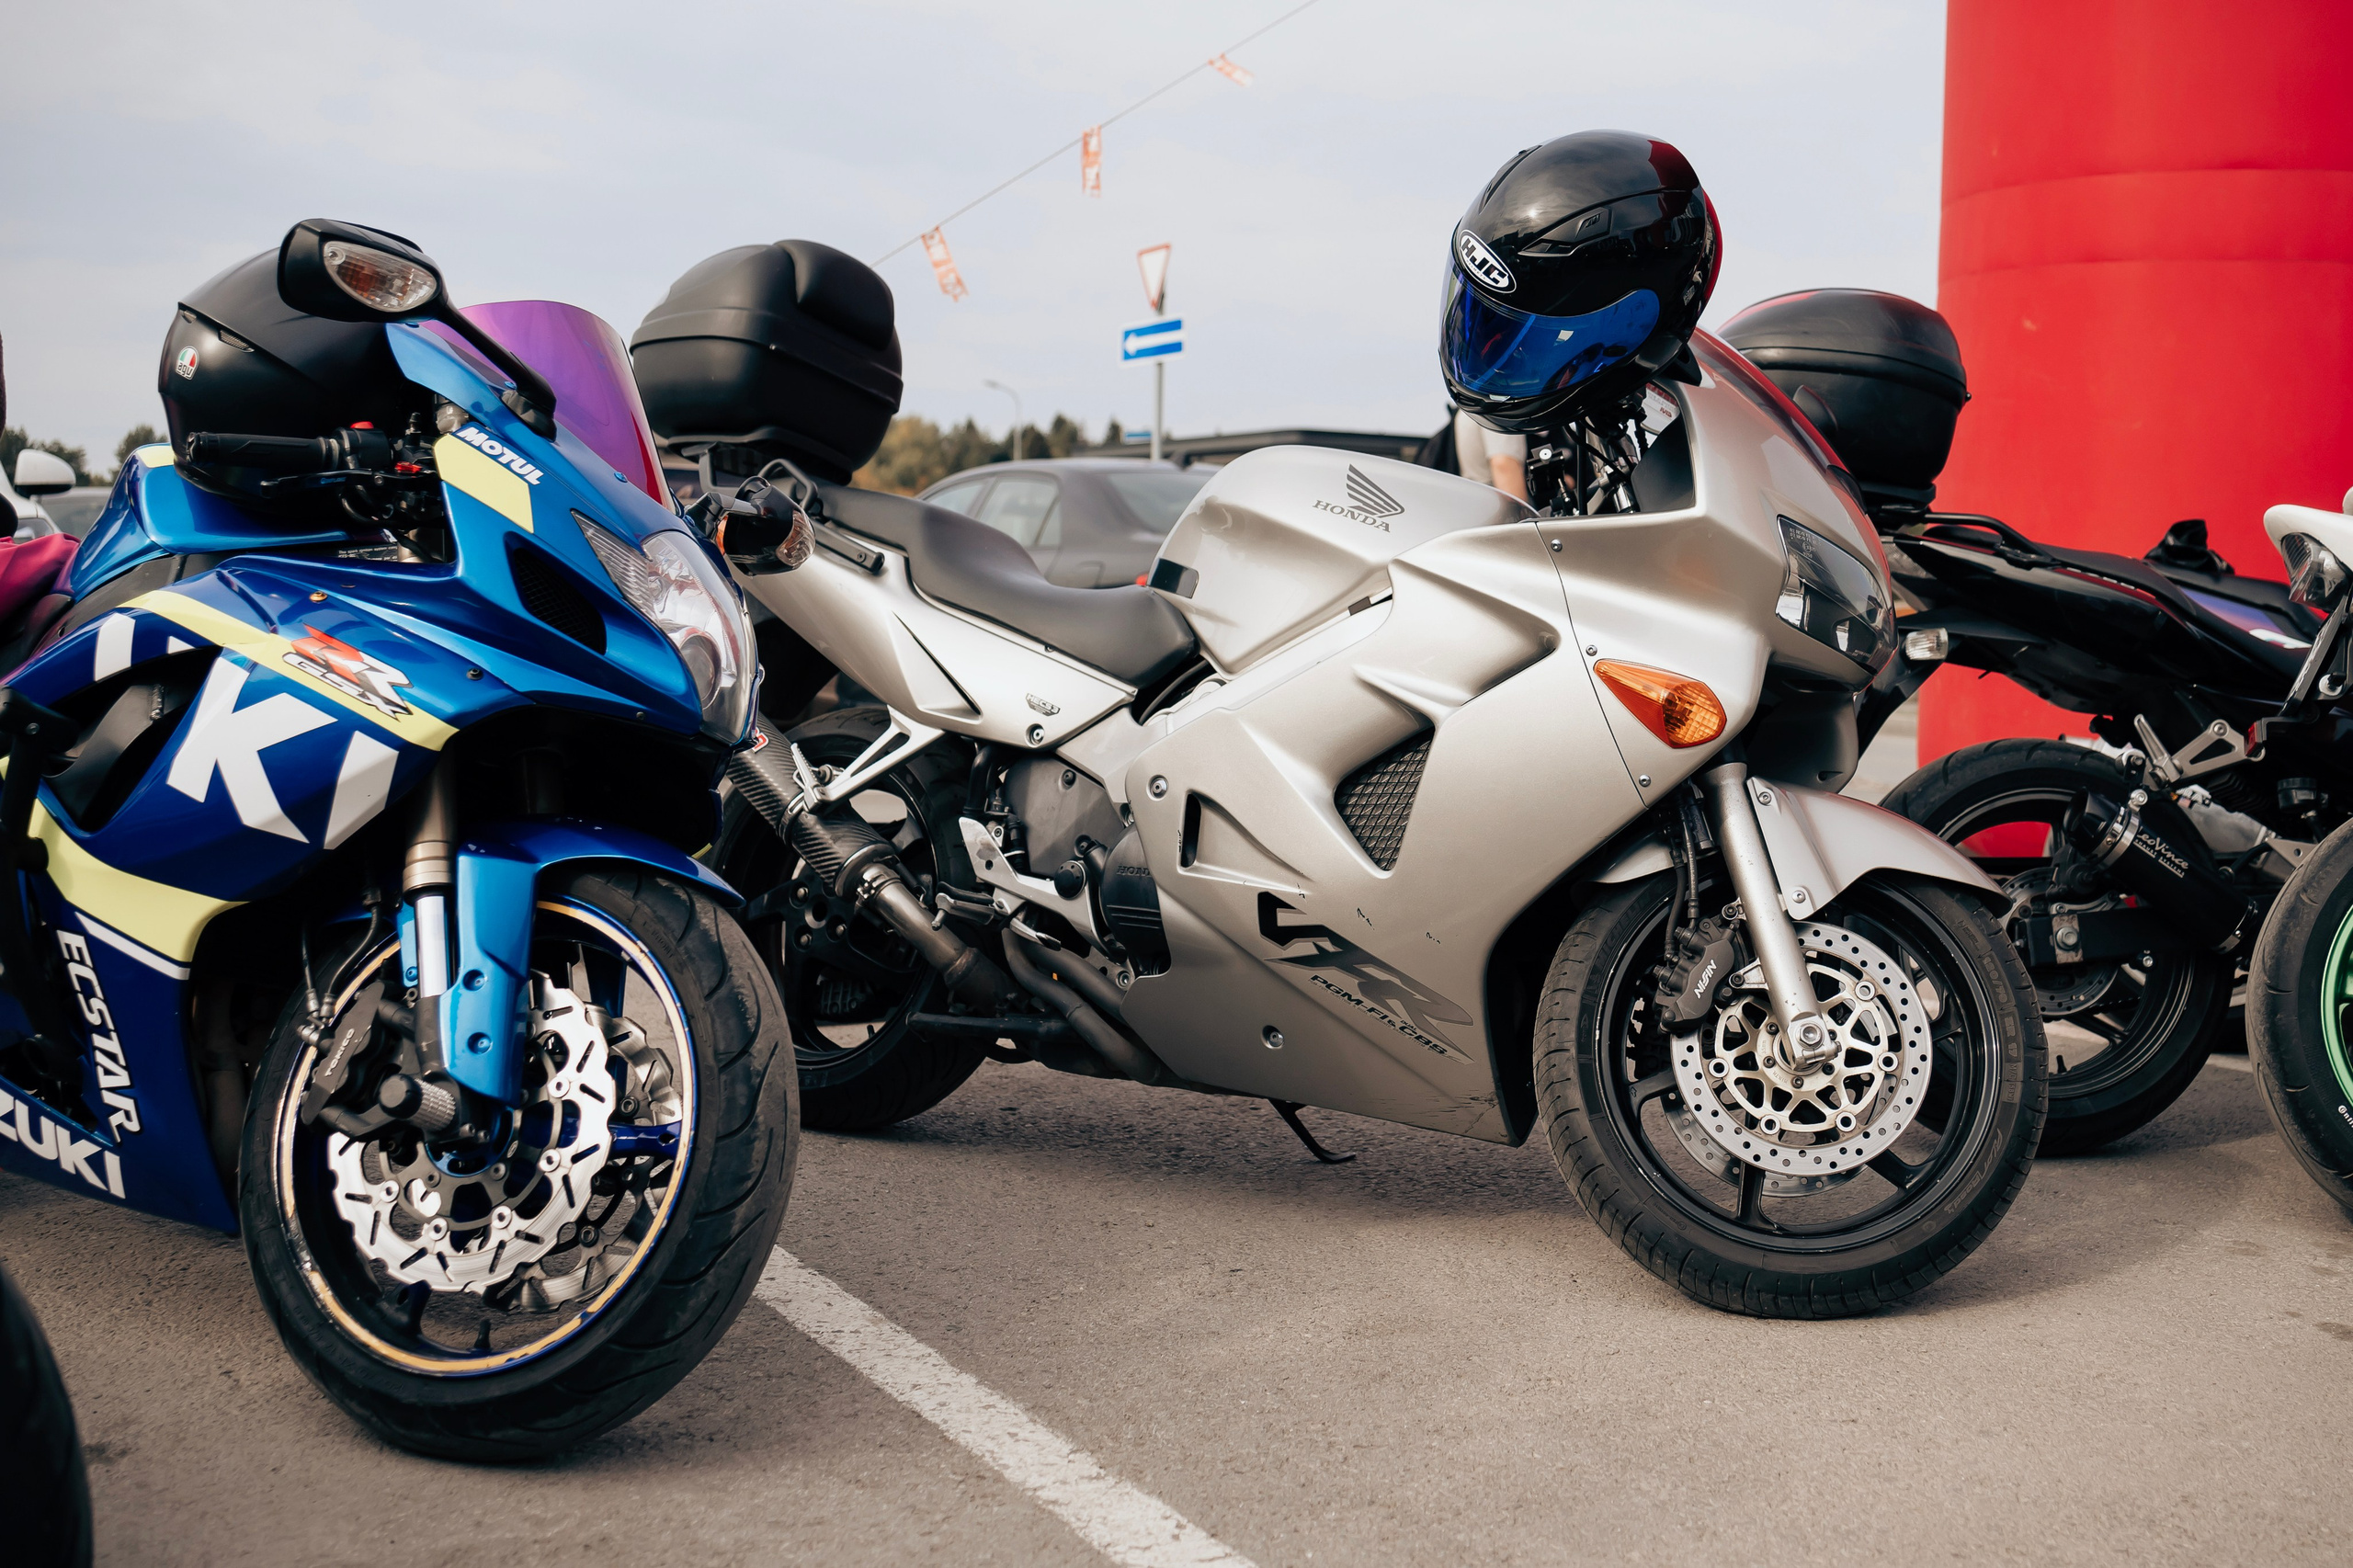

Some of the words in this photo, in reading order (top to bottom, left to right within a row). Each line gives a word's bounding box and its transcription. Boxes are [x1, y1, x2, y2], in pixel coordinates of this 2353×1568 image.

[1461, 238, 1507, 285] HJC
[456, 426, 544, 485] MOTUL
[1313, 500, 1390, 532] HONDA
[1116, 865, 1153, 877] HOND
[56, 929, 141, 1142] ECSTAR
[324, 1028, 355, 1077] TOKICO
[1399, 1026, 1448, 1054] CBS
